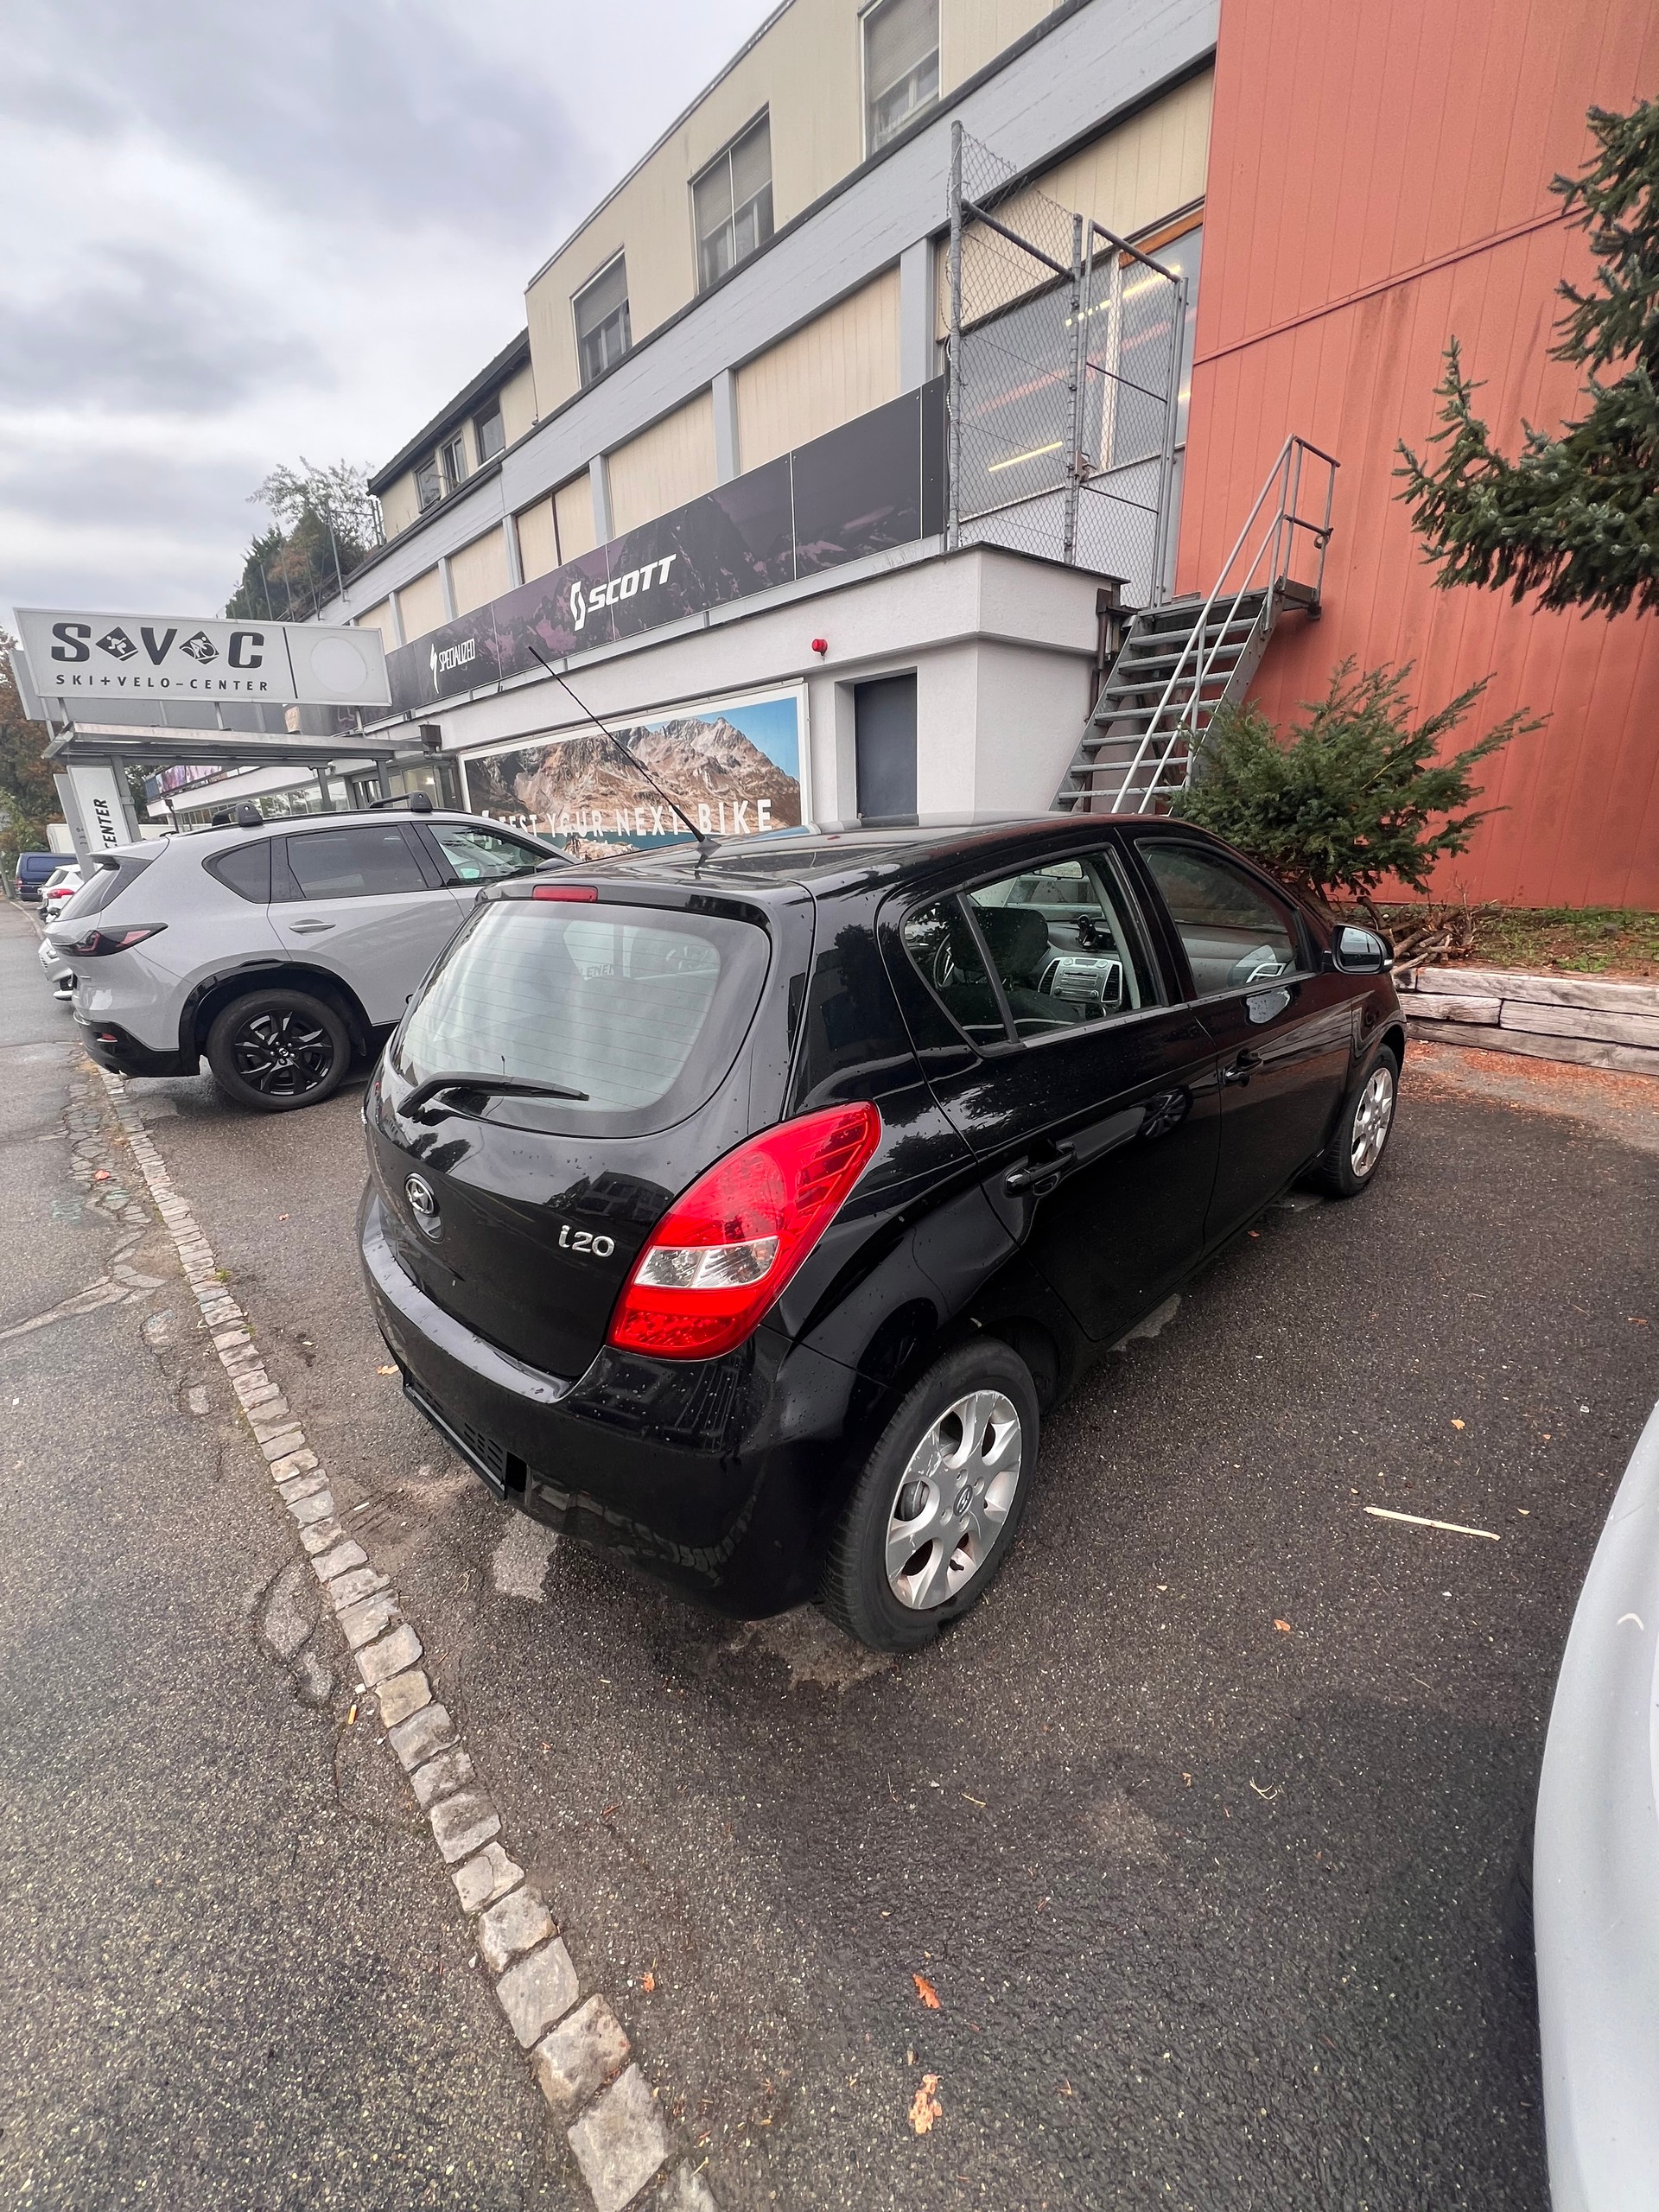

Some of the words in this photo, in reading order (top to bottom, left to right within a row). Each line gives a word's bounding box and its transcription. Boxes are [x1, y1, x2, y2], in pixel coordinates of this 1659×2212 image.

[588, 553, 677, 613] SCOTT
[547, 809, 604, 838] YOUR
[616, 804, 680, 836] NEXT
[697, 798, 772, 834] BIKE
[558, 1224, 614, 1257] i20
